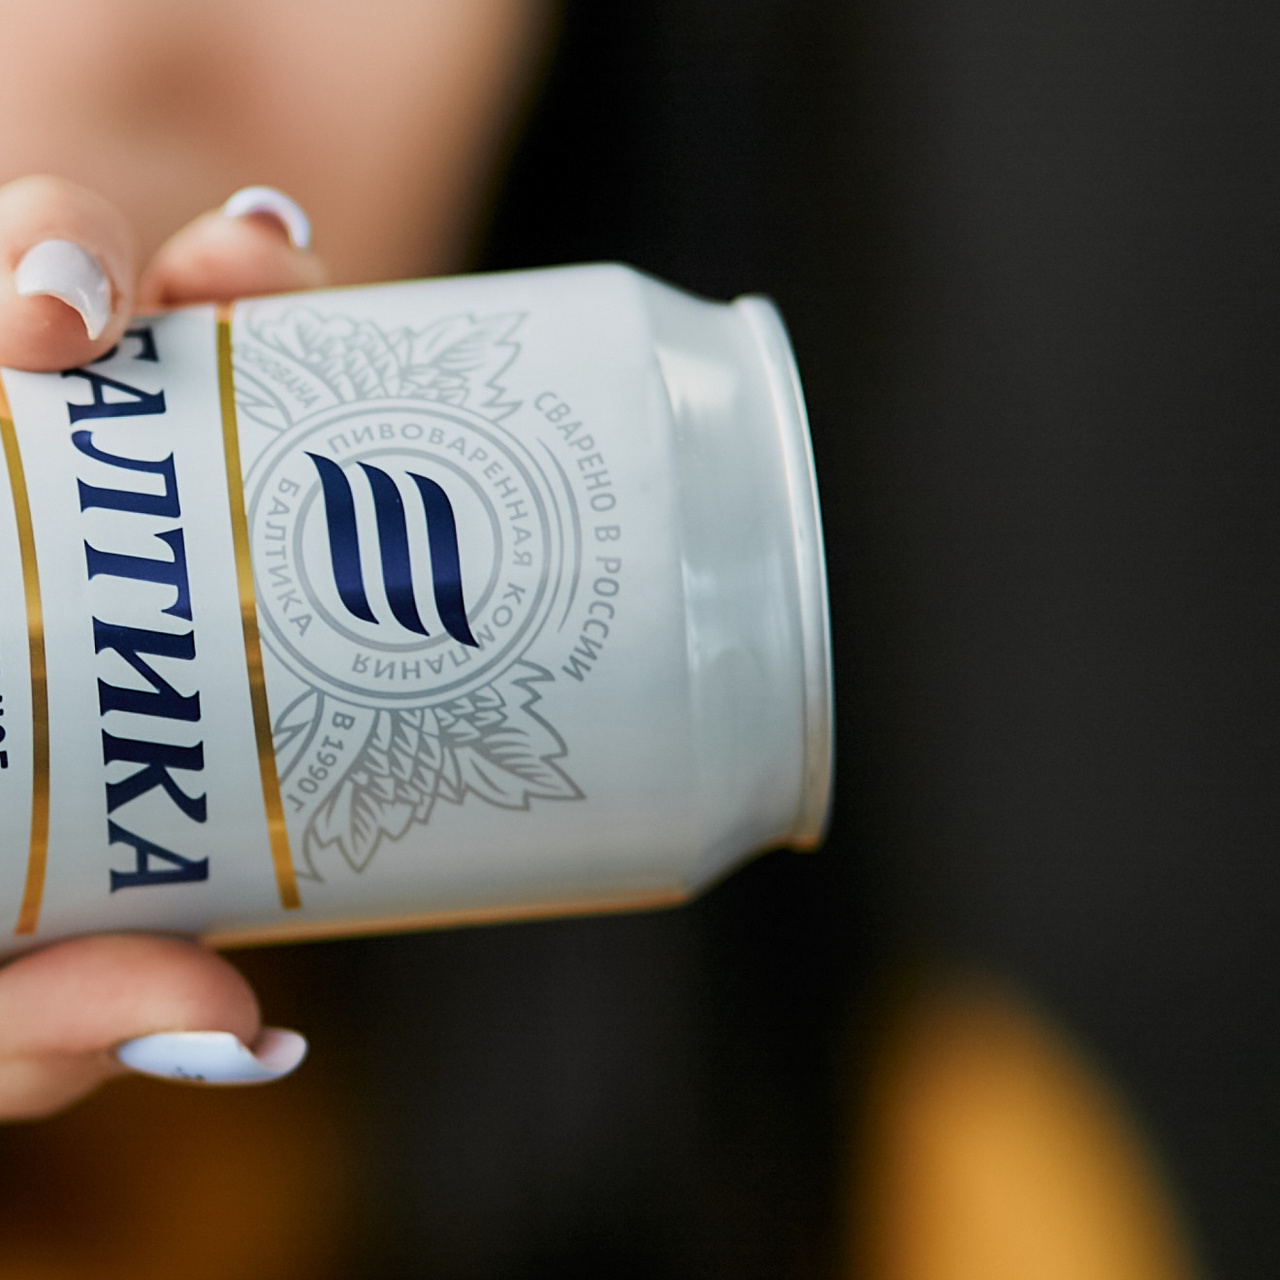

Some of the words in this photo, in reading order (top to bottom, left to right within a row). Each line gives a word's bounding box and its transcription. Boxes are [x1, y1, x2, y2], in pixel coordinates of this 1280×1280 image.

[326, 422, 533, 567] ПИВОВАРЕННАЯ
[533, 390, 617, 513] СВАРЕНО
[264, 476, 314, 637] БАЛТИКА
[595, 524, 621, 543] В
[350, 581, 526, 681] КОМПАНИЯ
[561, 556, 622, 682] РОССИИ
